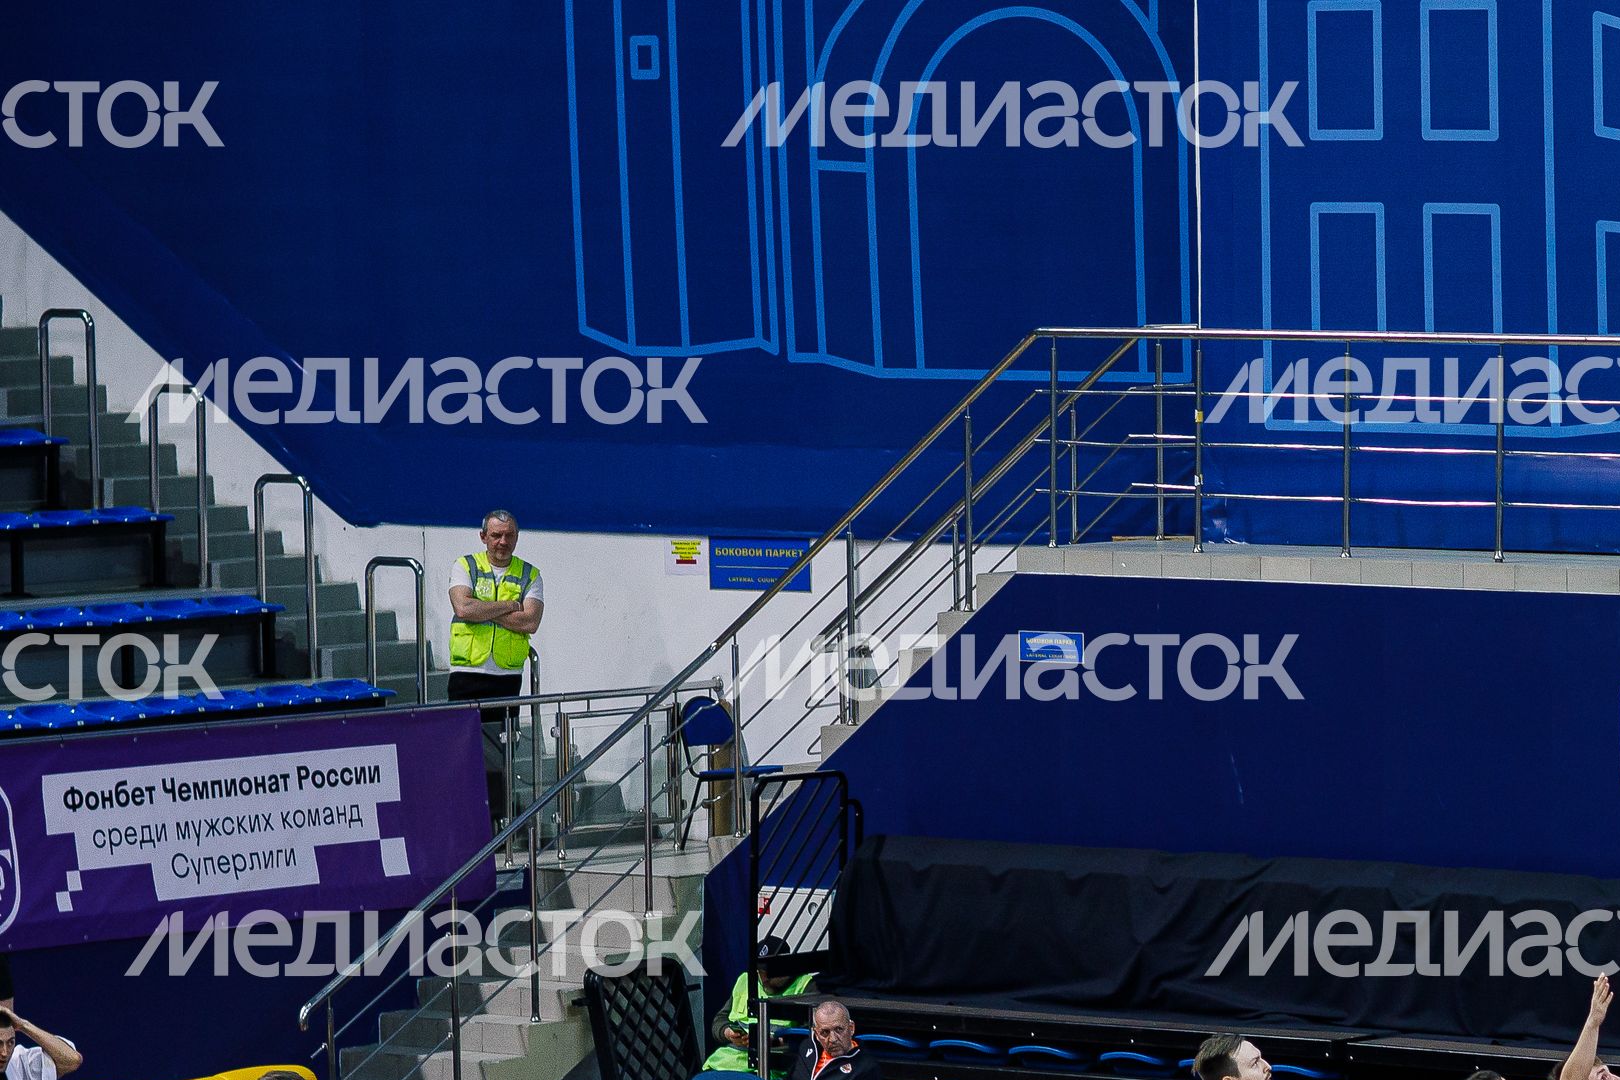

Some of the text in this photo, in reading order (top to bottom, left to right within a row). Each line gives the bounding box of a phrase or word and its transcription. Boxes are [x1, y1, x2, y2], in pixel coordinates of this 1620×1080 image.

[765, 548, 804, 558] ПАРКЕТ
[62, 764, 381, 813] Фонбет Чемпионат России
[92, 803, 364, 855] среди мужских команд
[171, 847, 297, 880] Суперлиги
